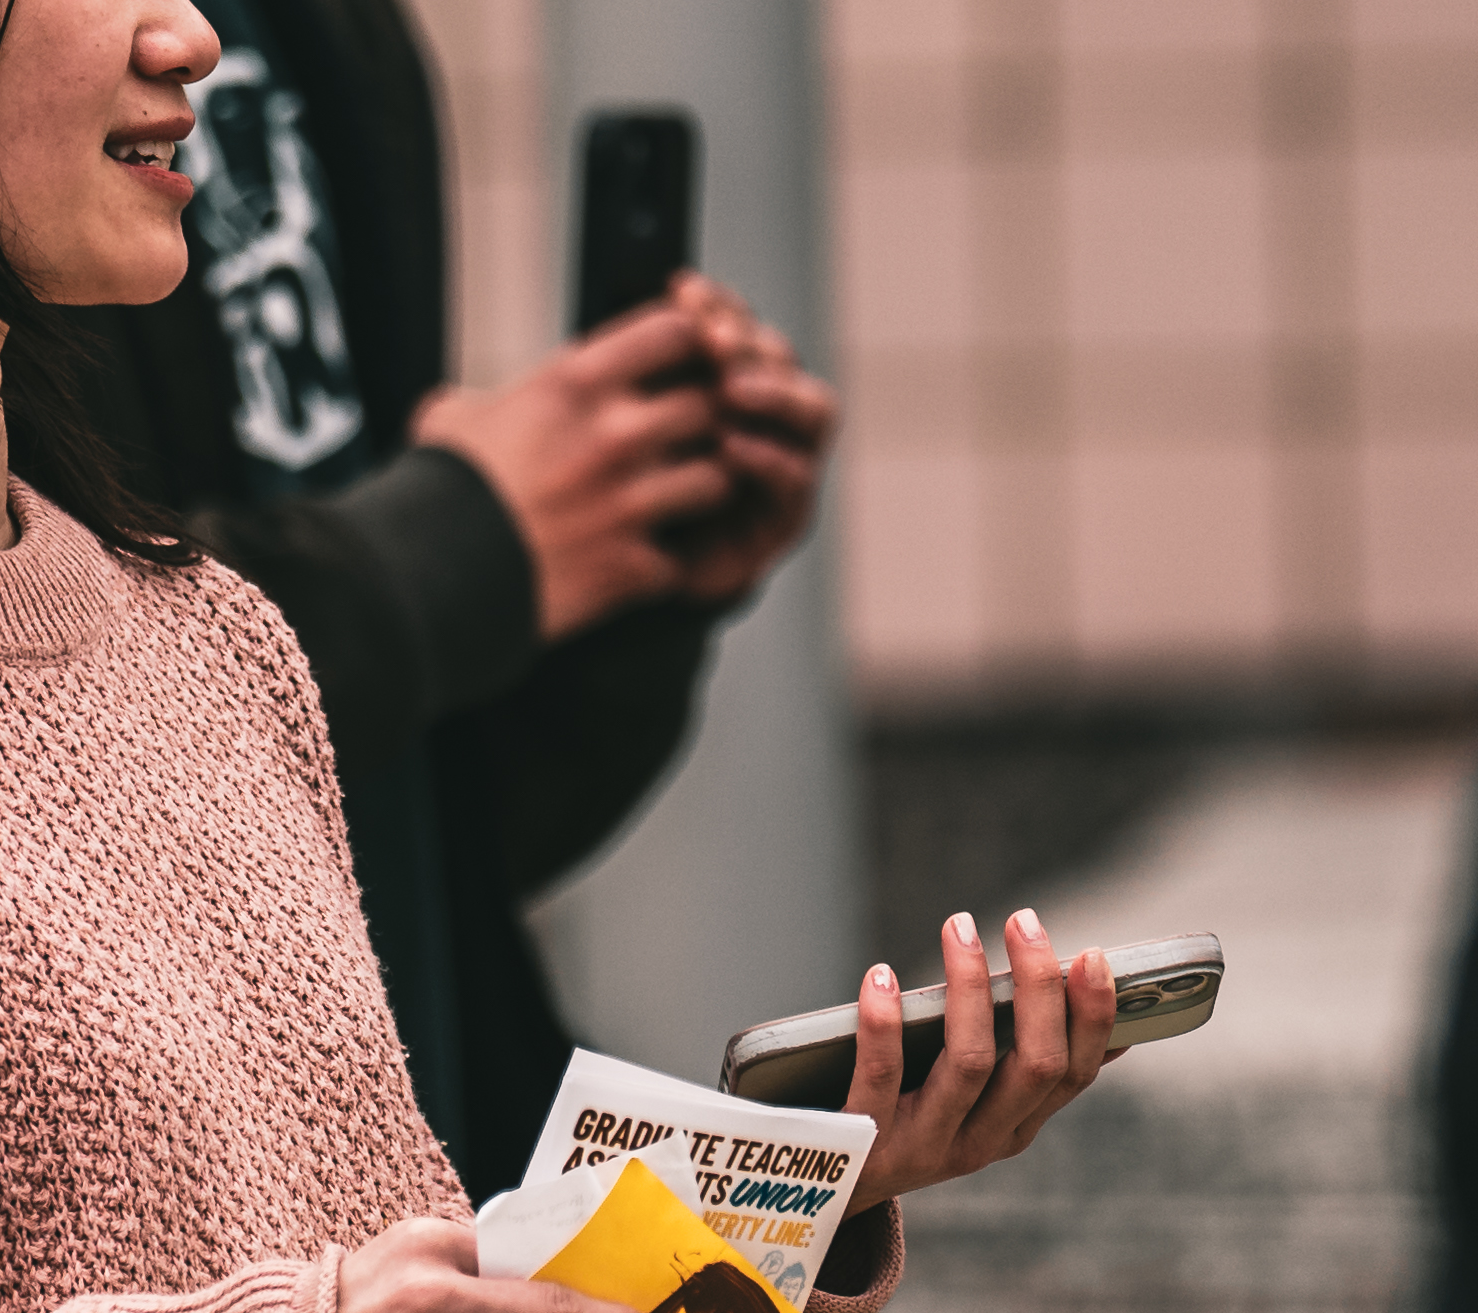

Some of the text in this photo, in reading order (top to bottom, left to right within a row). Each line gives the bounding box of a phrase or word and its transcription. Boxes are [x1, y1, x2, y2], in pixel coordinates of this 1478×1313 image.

[725, 1136, 850, 1185] TEACHING
[729, 1177, 837, 1218] UNION!
[702, 1210, 816, 1249] VERTY LINE:
